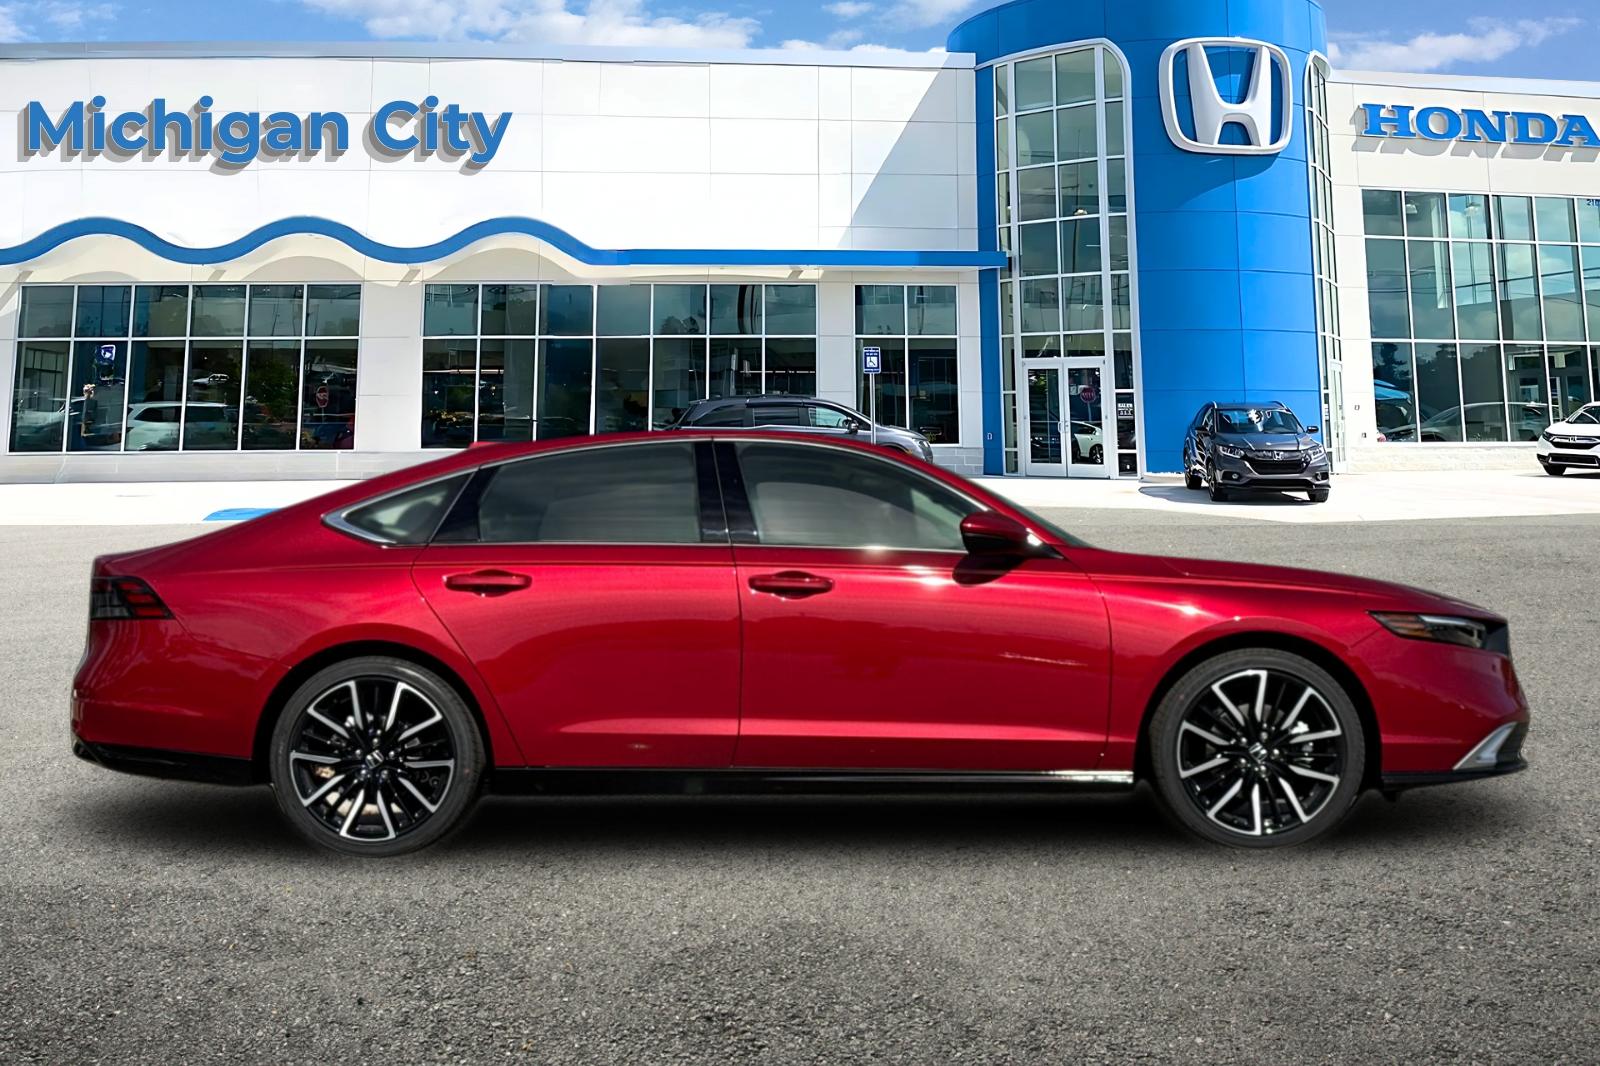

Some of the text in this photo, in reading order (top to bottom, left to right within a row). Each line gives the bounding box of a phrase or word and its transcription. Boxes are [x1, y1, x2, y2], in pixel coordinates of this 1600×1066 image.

[28, 95, 513, 164] Michigan City
[1361, 102, 1600, 148] HONDA
